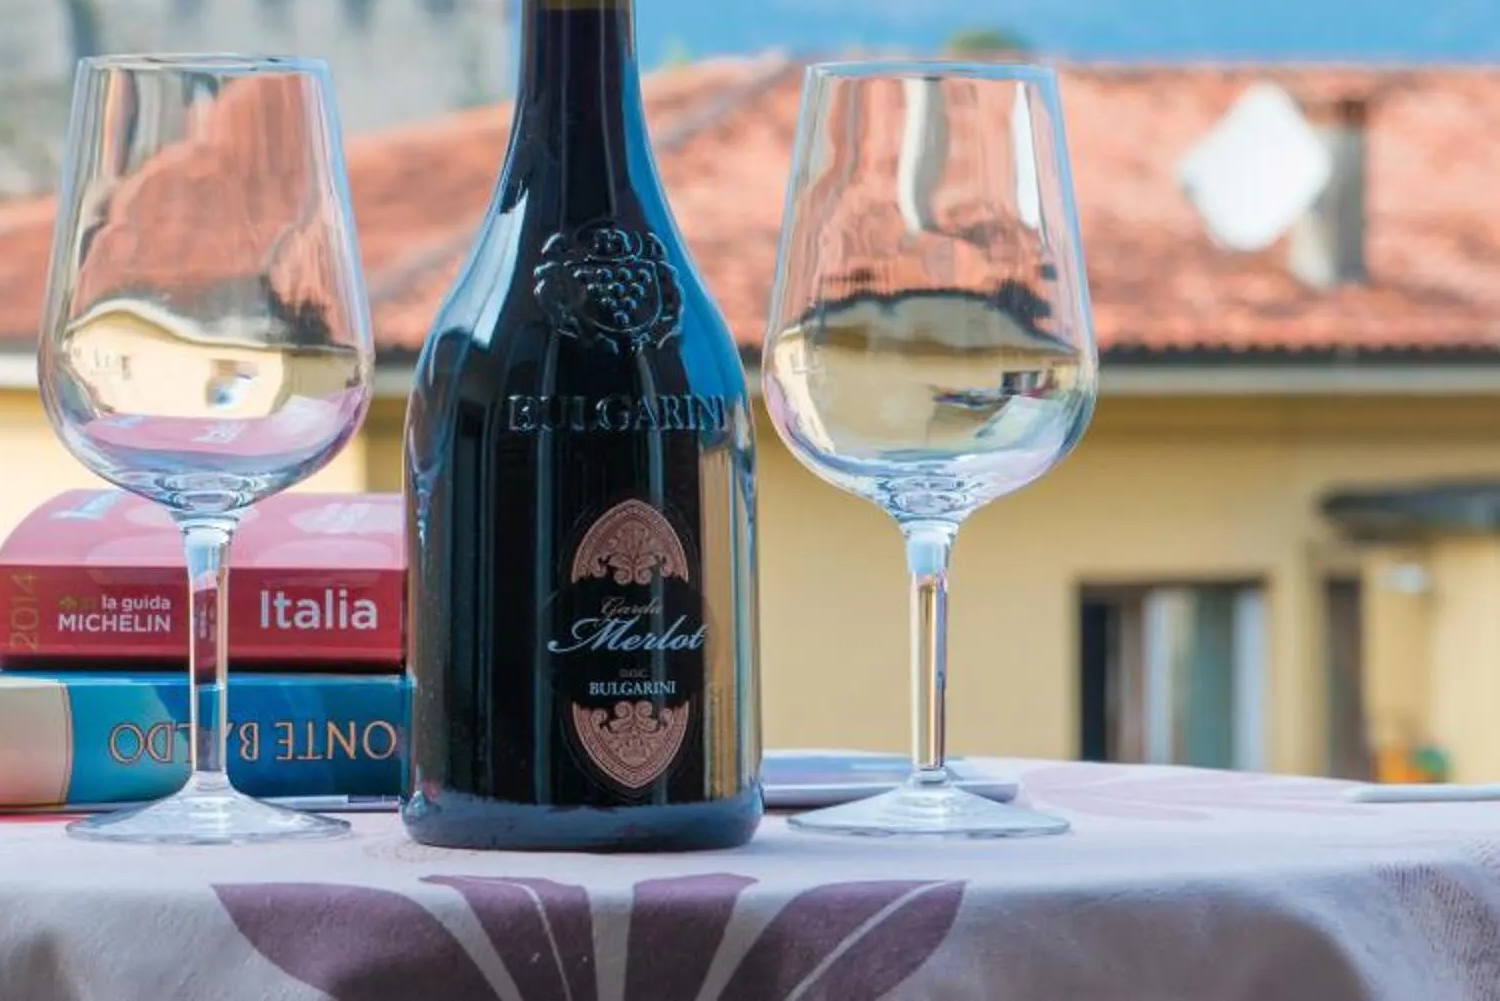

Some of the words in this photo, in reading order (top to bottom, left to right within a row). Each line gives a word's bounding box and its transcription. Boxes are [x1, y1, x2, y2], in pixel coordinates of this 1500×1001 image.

[508, 393, 733, 432] BULGARINI
[9, 571, 39, 650] 2014
[102, 594, 117, 609] la
[122, 594, 171, 611] guida
[260, 588, 378, 630] Italia
[57, 613, 171, 632] MICHELIN
[547, 614, 709, 653] Merlot
[588, 680, 677, 697] BULGARINI
[108, 721, 260, 764] BLDO
[275, 719, 398, 761] ONTE
